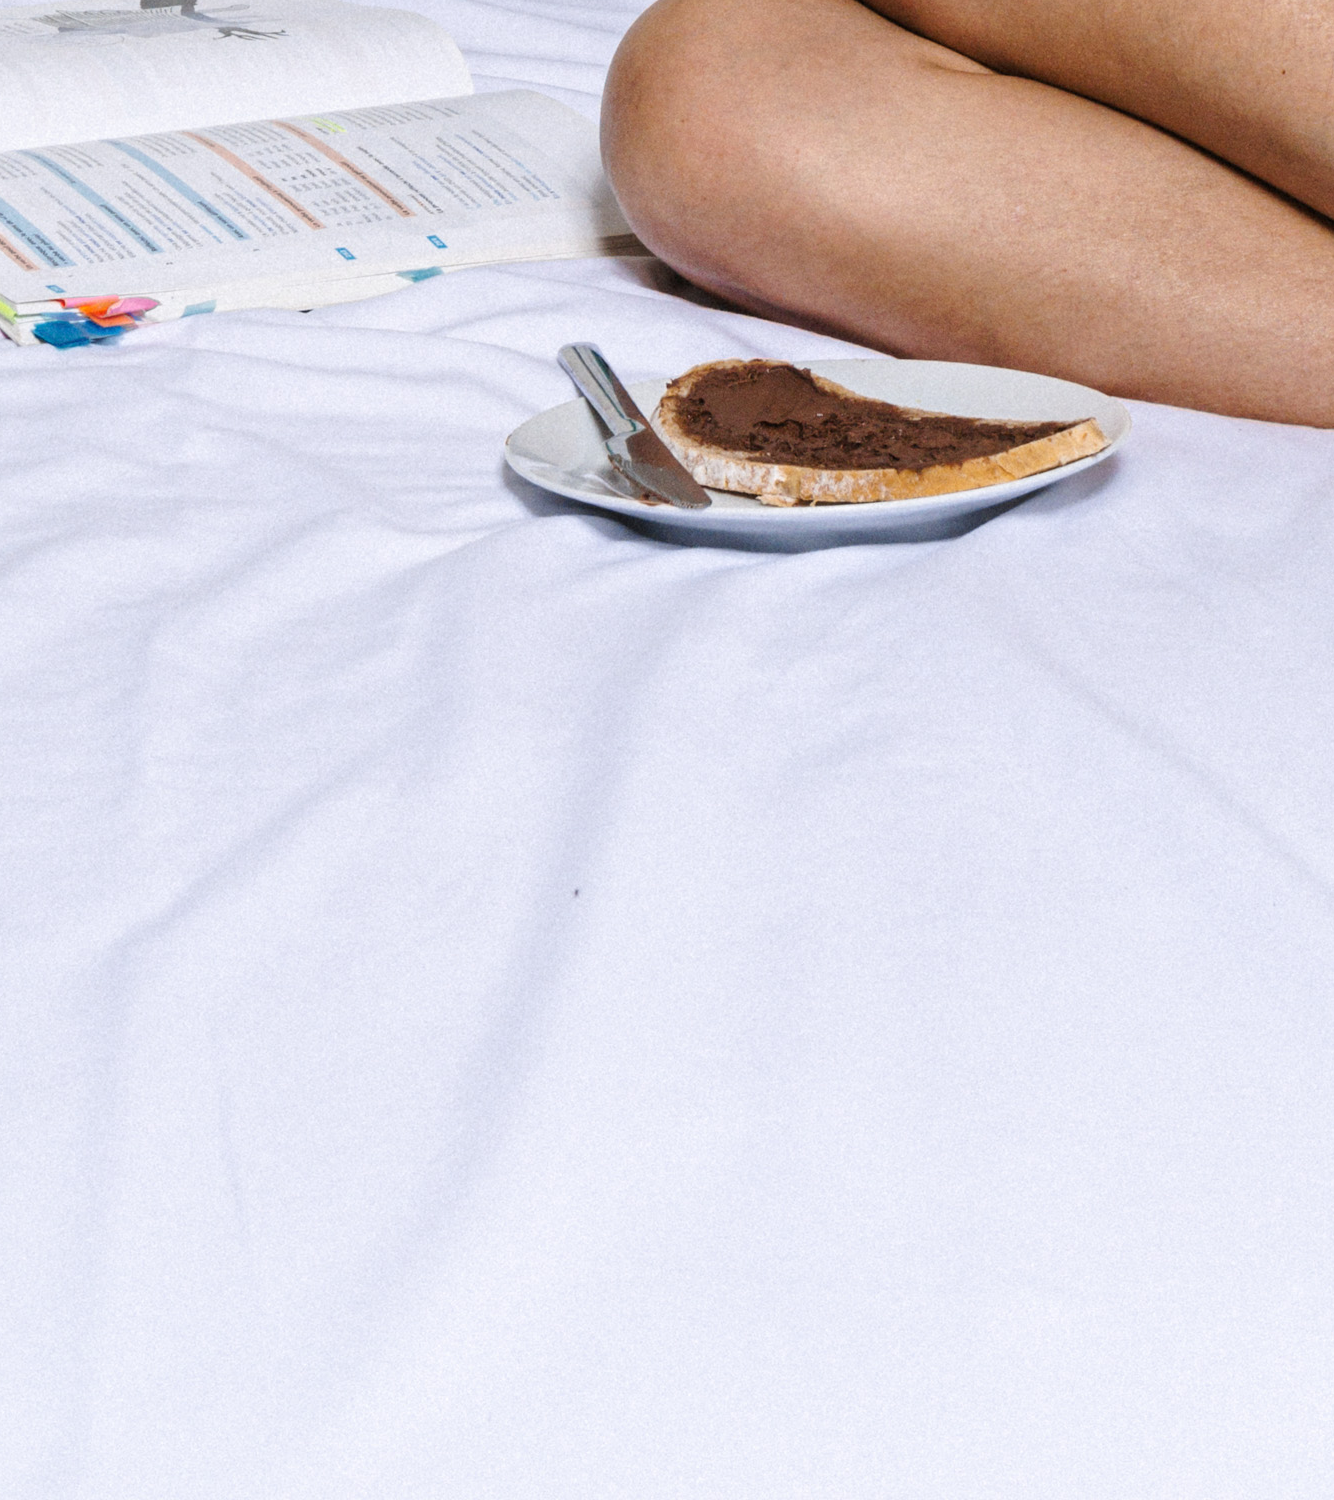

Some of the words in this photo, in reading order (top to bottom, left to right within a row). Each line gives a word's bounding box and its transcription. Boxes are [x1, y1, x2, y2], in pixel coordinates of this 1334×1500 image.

[386, 199, 407, 210] verbe
[214, 215, 229, 223] sens
[229, 229, 246, 237] Avec
